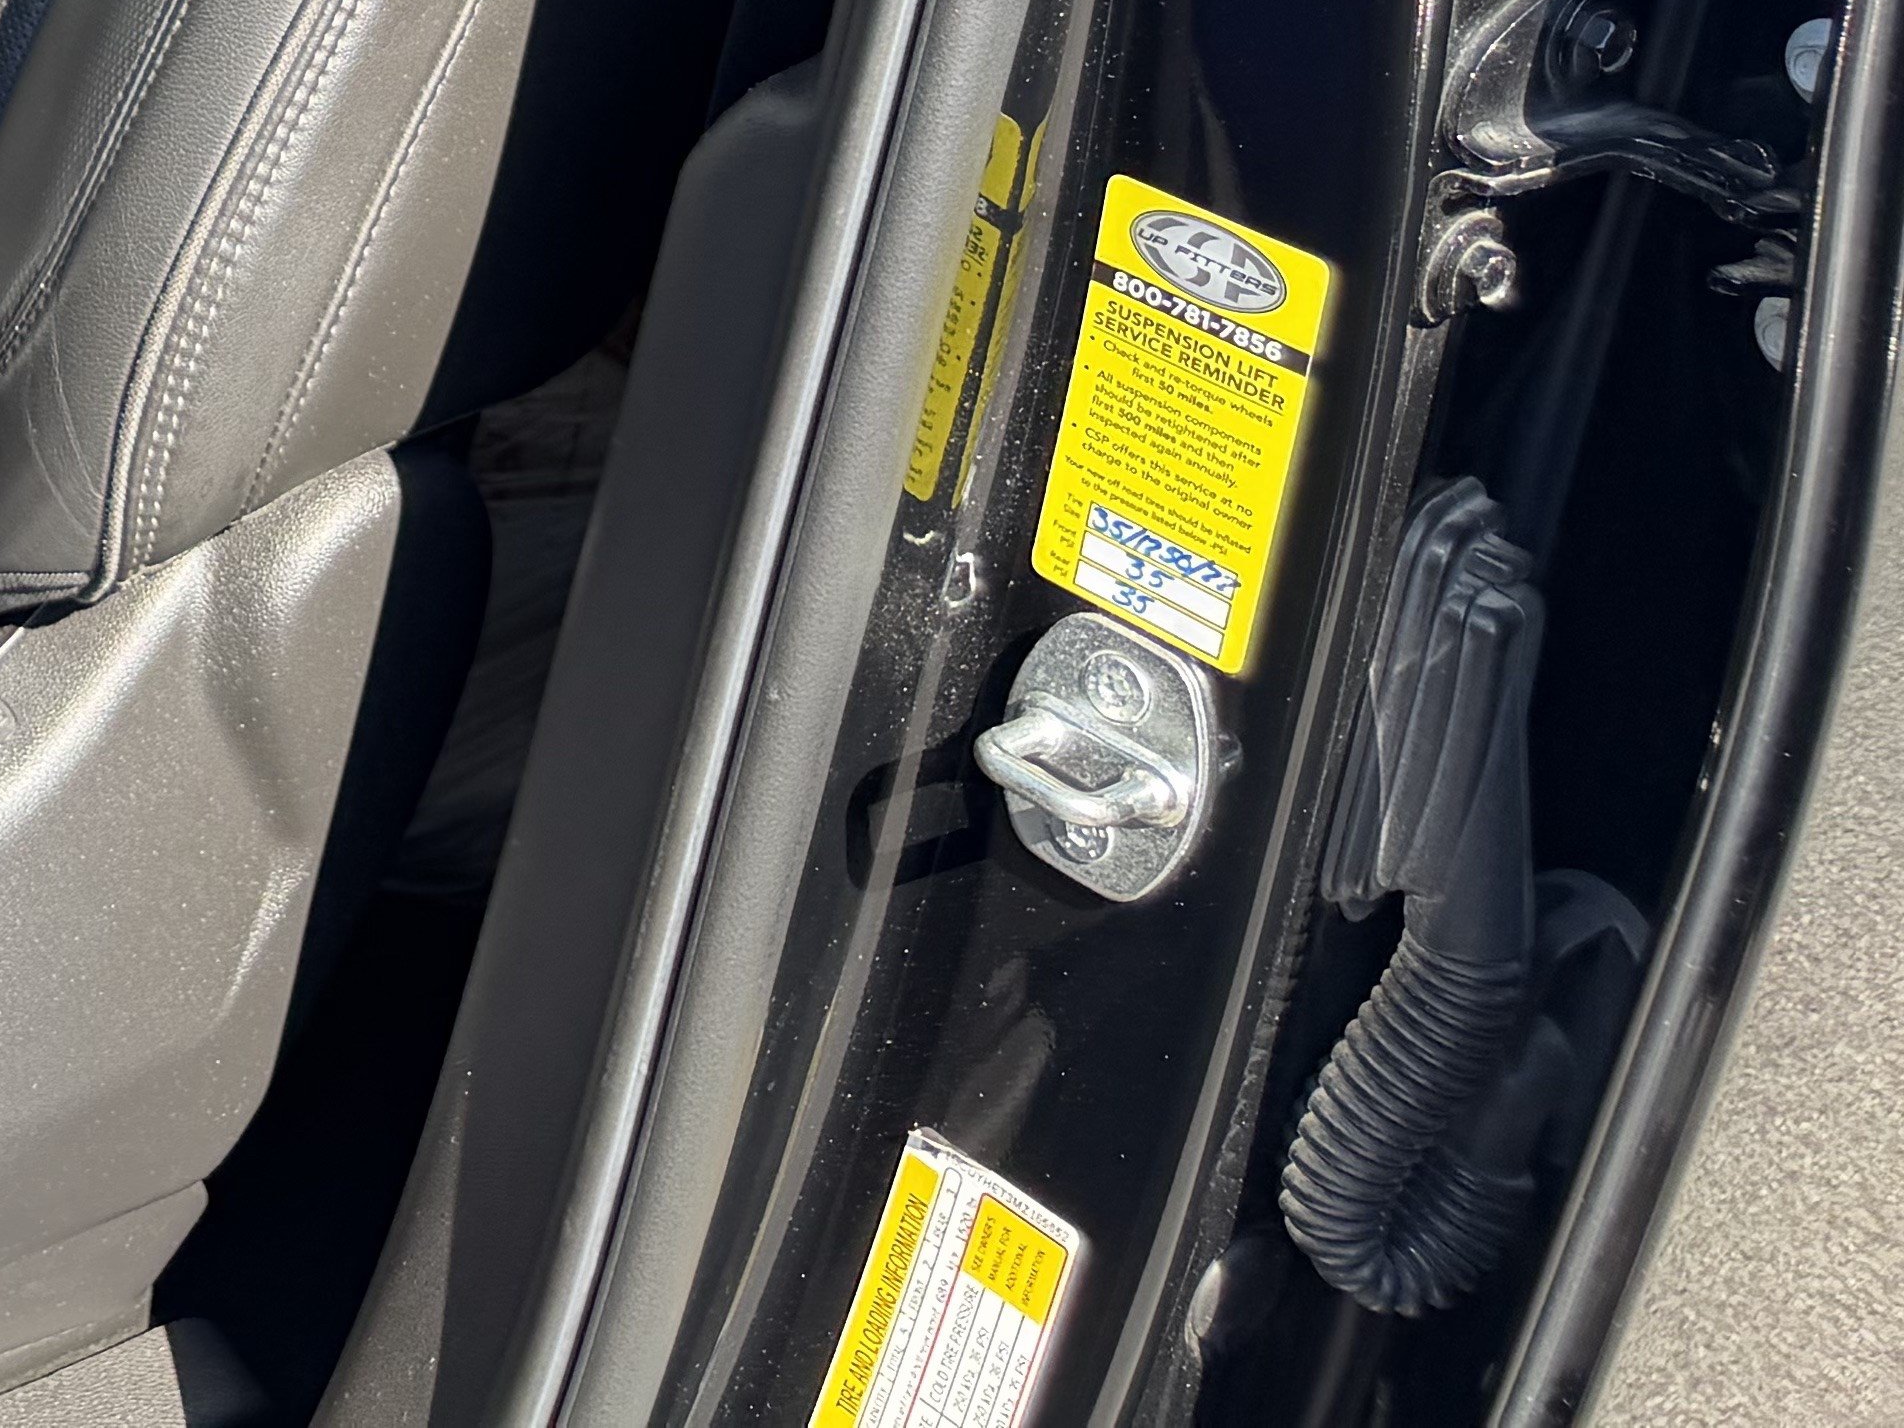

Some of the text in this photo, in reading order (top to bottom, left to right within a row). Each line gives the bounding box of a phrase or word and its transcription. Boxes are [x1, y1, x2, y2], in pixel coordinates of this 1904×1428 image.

[1137, 227, 1278, 297] UP FITTERS
[1106, 299, 1278, 390] SUSPENSION LIFT
[1112, 271, 1282, 362] 800-781-7856
[1093, 310, 1285, 410] SERVICE REMINDER
[1103, 339, 1273, 427] Check and re-torque wheels
[1131, 367, 1155, 386] first
[1158, 380, 1174, 395] 50
[1088, 407, 1146, 444] inspected
[1149, 438, 1181, 462] again
[1091, 394, 1235, 472] first 500 miles and then
[1094, 381, 1261, 469] should be retightened after
[1097, 368, 1262, 456] All suspension components
[1081, 440, 1251, 531] charge to the original owner
[1085, 426, 1253, 518] CSP offers this service at no
[1167, 507, 1198, 529] should
[1200, 523, 1213, 536] be
[1112, 579, 1155, 614] 35
[1126, 551, 1174, 588] 35
[880, 1191, 928, 1293] INFORMATION
[999, 1225, 1011, 1246] FOR
[858, 1285, 896, 1355] LOADING
[928, 1283, 978, 1404] COLD TIRE PRESSURE
[836, 1379, 863, 1418] TIRE
[847, 1347, 874, 1385] AND
